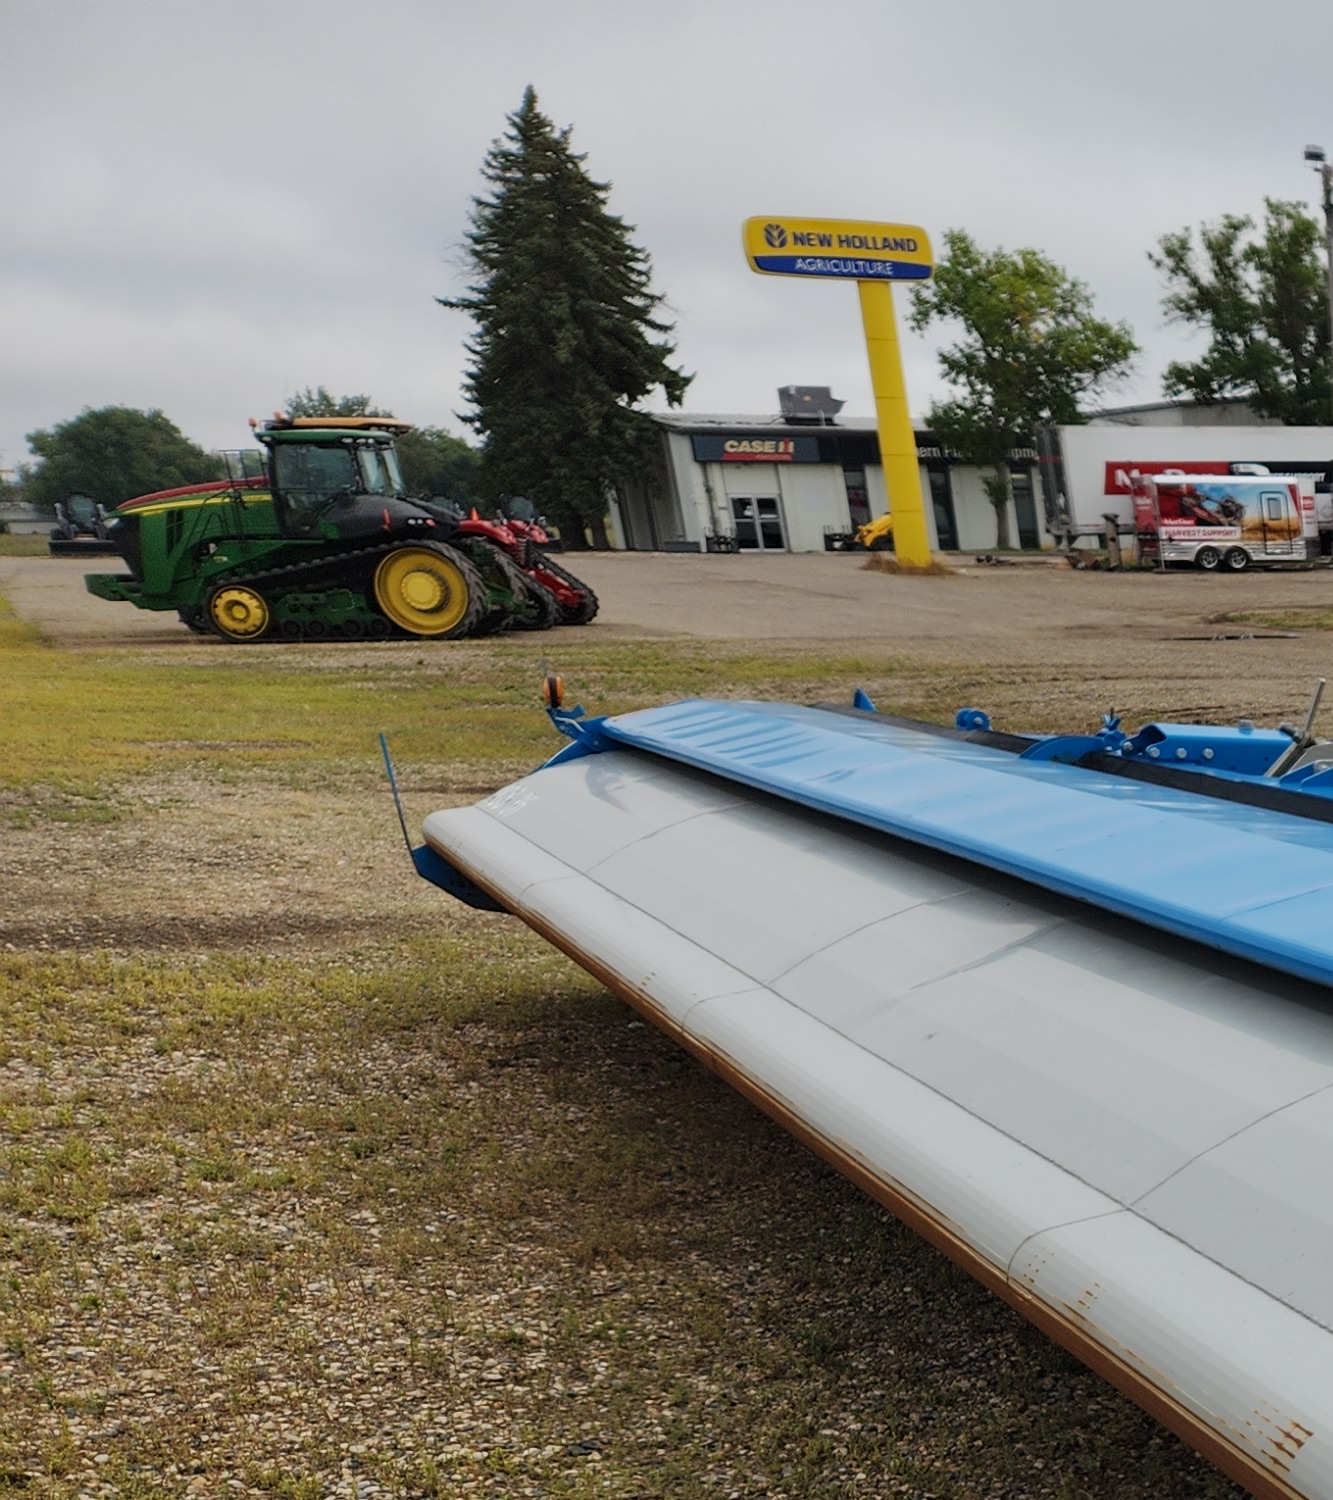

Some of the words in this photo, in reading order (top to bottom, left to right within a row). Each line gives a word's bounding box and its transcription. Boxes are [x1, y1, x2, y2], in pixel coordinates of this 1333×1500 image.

[791, 231, 832, 248] NEW
[838, 234, 918, 252] HOLLAND
[795, 258, 894, 275] AGRICULTURE
[724, 440, 777, 452] CASE
